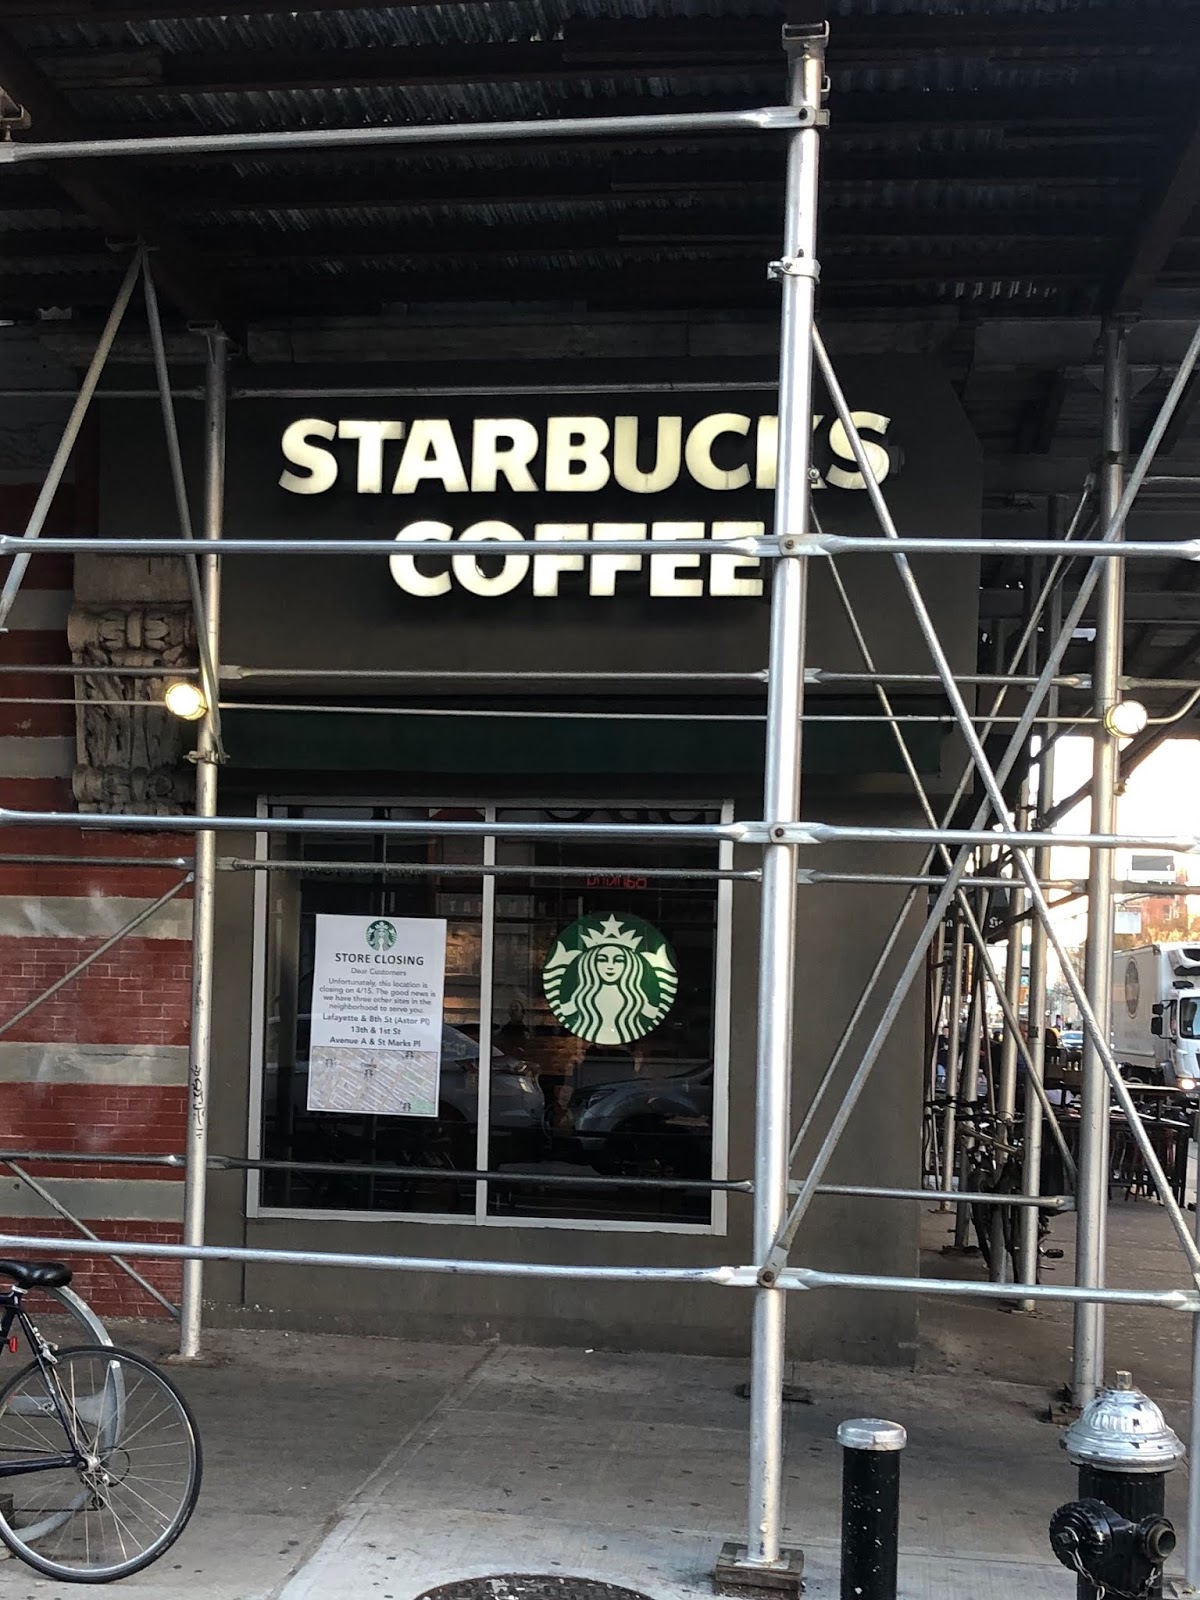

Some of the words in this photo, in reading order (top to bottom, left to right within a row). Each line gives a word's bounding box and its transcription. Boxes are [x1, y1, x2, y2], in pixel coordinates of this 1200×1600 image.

[278, 411, 891, 495] STARBUCKS
[389, 520, 765, 597] COFFEE
[335, 952, 372, 964] STORE
[374, 954, 425, 966] CLOSING
[350, 967, 368, 975] Dear
[369, 967, 407, 977] Customers
[378, 979, 392, 987] this
[392, 980, 421, 988] location
[422, 981, 429, 989] is
[319, 985, 344, 995] closing
[375, 987, 389, 996] The
[390, 989, 410, 998] good
[430, 990, 437, 998] is
[334, 994, 352, 1002] have
[353, 995, 372, 1003] three
[373, 996, 392, 1004] other
[394, 997, 410, 1005] sites
[419, 998, 432, 1006] the
[328, 1002, 379, 1012] neighborhood
[380, 1004, 388, 1012] to
[389, 1005, 408, 1013] serve
[322, 1012, 359, 1023] Lafayette
[361, 1014, 367, 1022] &
[369, 1014, 382, 1023] 8th
[384, 1015, 393, 1024] St
[394, 1016, 419, 1025] (Astor
[351, 1025, 369, 1034] 13th
[370, 1026, 377, 1034] &
[379, 1026, 391, 1035] 1st
[392, 1027, 402, 1035] St
[329, 1035, 359, 1045] Avenue
[360, 1037, 368, 1045] A
[369, 1037, 376, 1046] &
[377, 1038, 386, 1046] St
[387, 1038, 412, 1047] Marks
[412, 1039, 422, 1048] Pl
